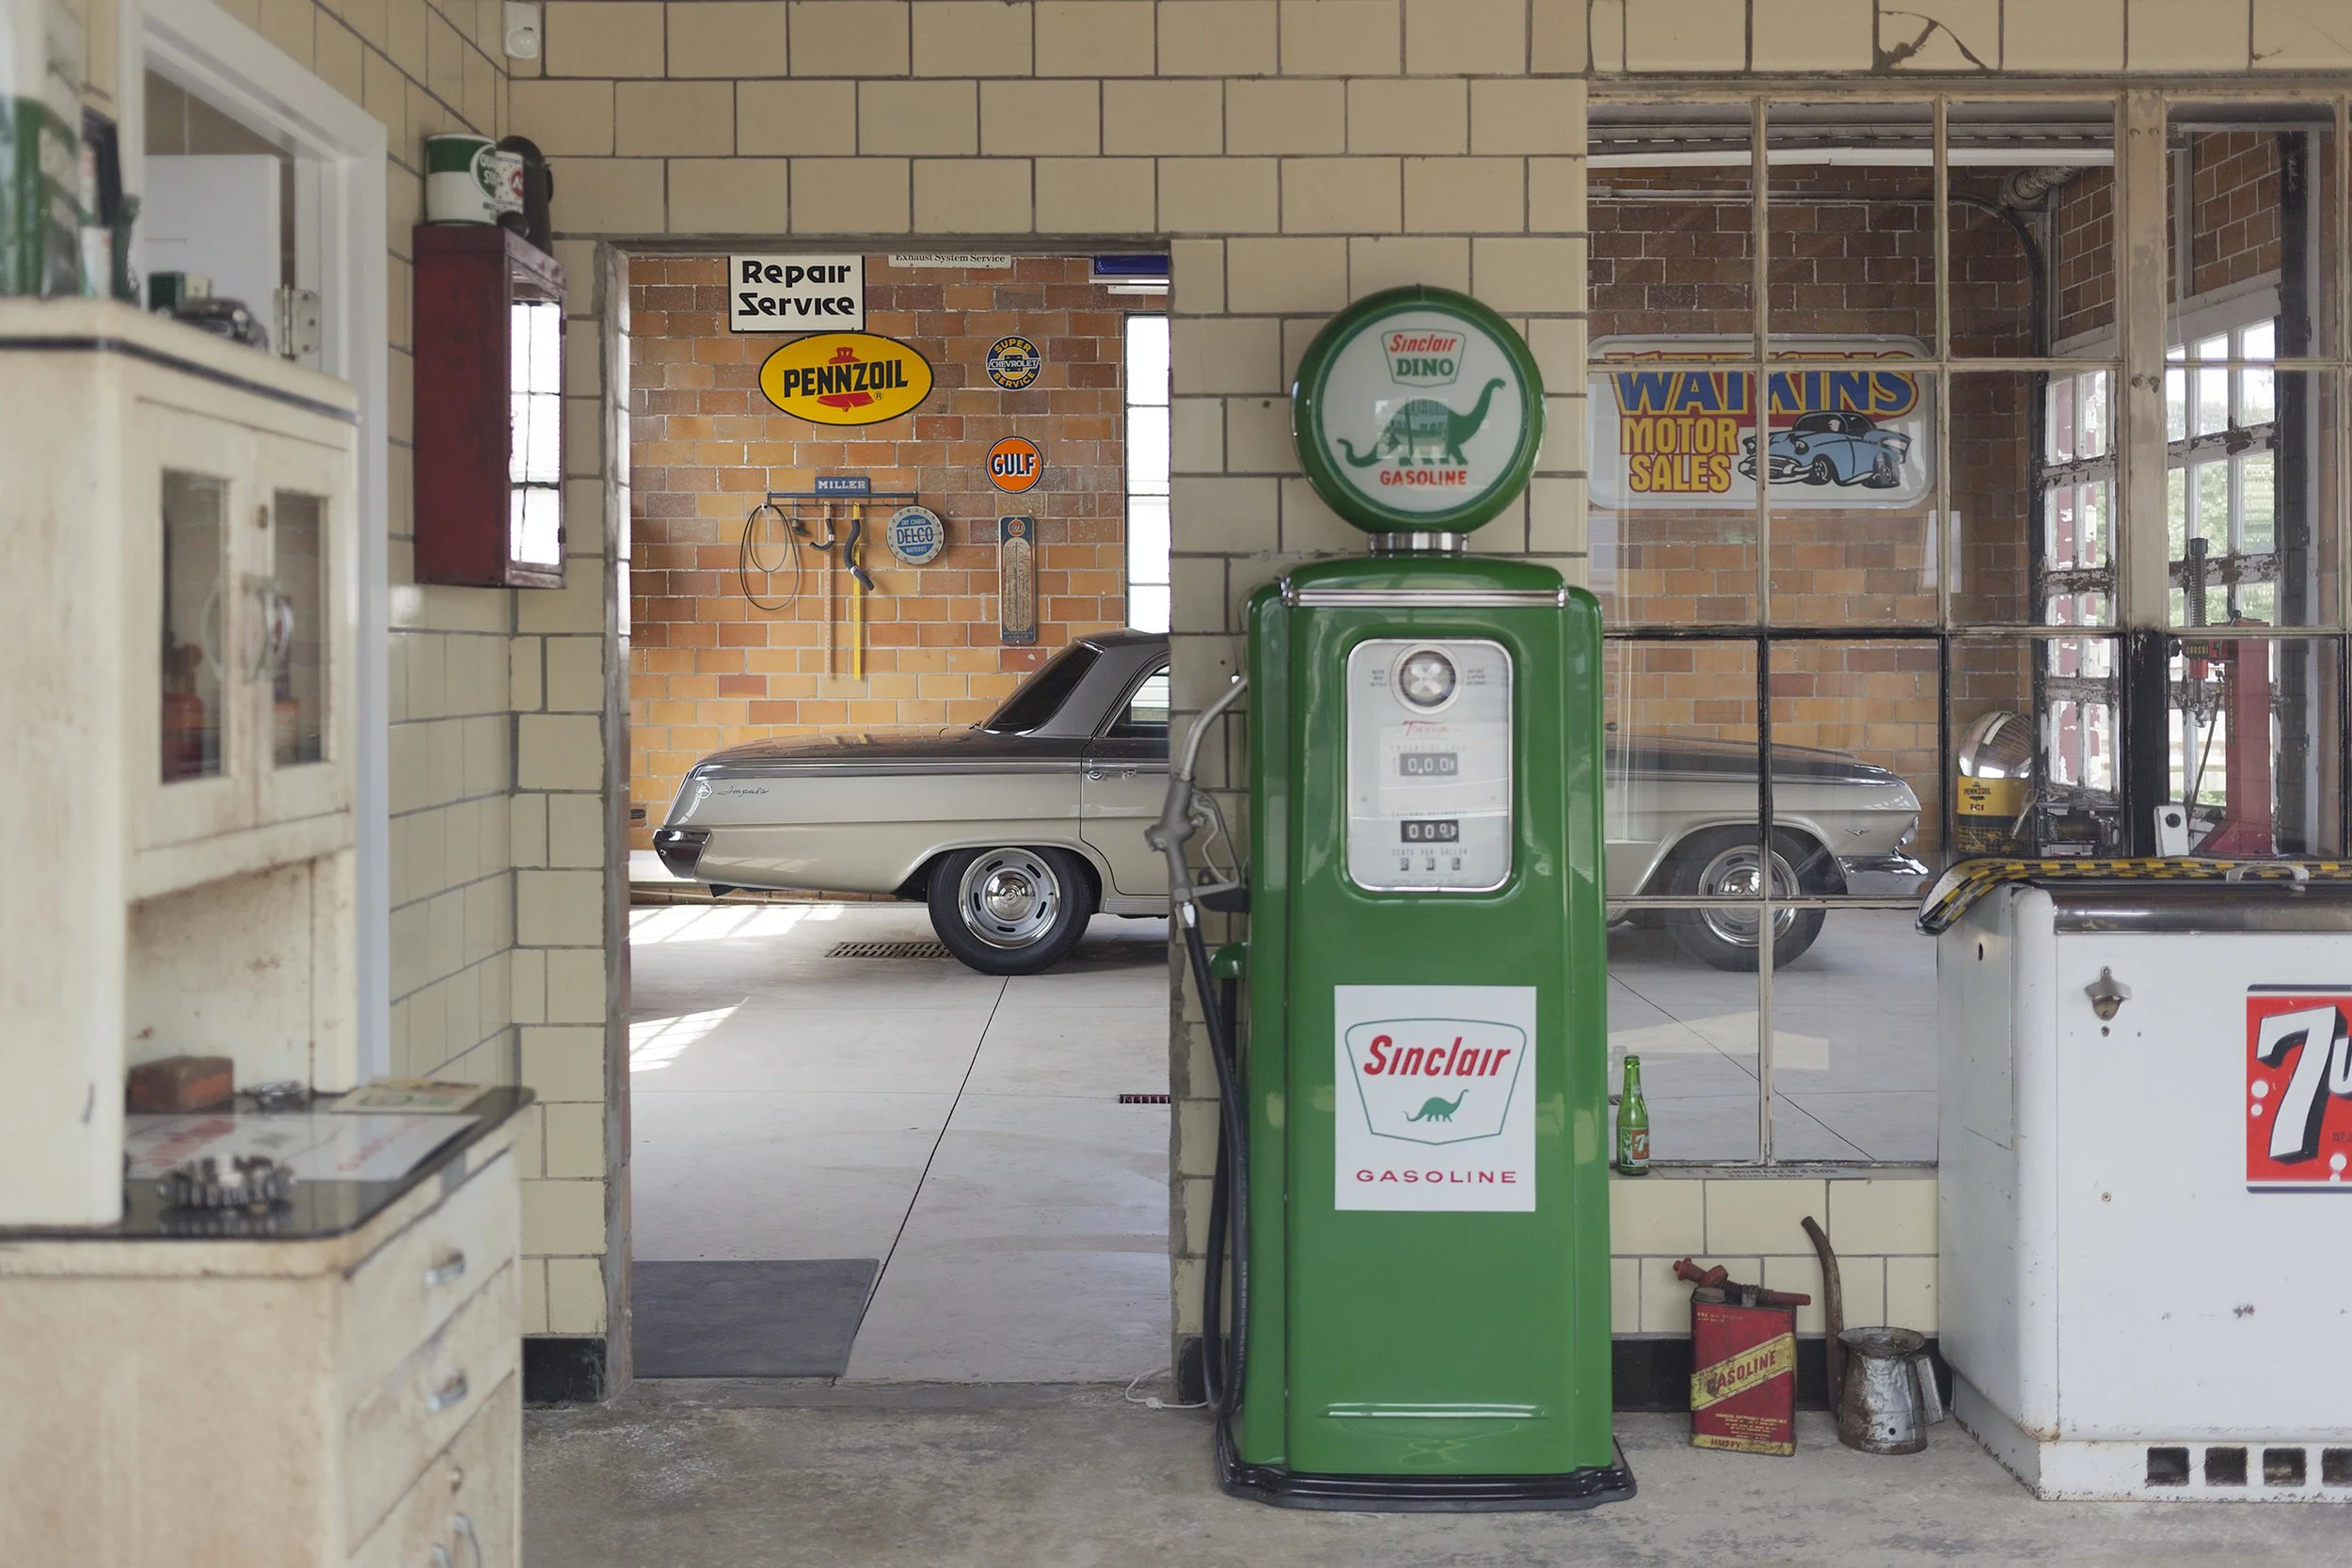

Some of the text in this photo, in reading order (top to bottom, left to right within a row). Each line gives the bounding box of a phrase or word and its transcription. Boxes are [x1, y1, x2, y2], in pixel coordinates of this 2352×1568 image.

[934, 254, 969, 263] System
[970, 254, 1006, 262] Service
[741, 261, 851, 288] Repair
[738, 293, 855, 316] Service
[994, 339, 1032, 354] SUPER
[1390, 333, 1457, 354] Sinclair
[991, 359, 1037, 368] CHEVROLET
[1395, 358, 1454, 377] DINO
[784, 359, 910, 399] PENNZOIL
[993, 371, 1036, 388] SERVICE
[1620, 417, 1740, 455] MOTOR
[991, 453, 1037, 477] GULF
[1629, 453, 1733, 493] SALES
[818, 481, 866, 490] MILLER
[1379, 470, 1468, 486] GASOLINE
[897, 526, 933, 545] DELCO
[717, 784, 771, 798] Impala
[1363, 1035, 1511, 1077] Sinclair
[1356, 1169, 1517, 1184] GASOLINE
